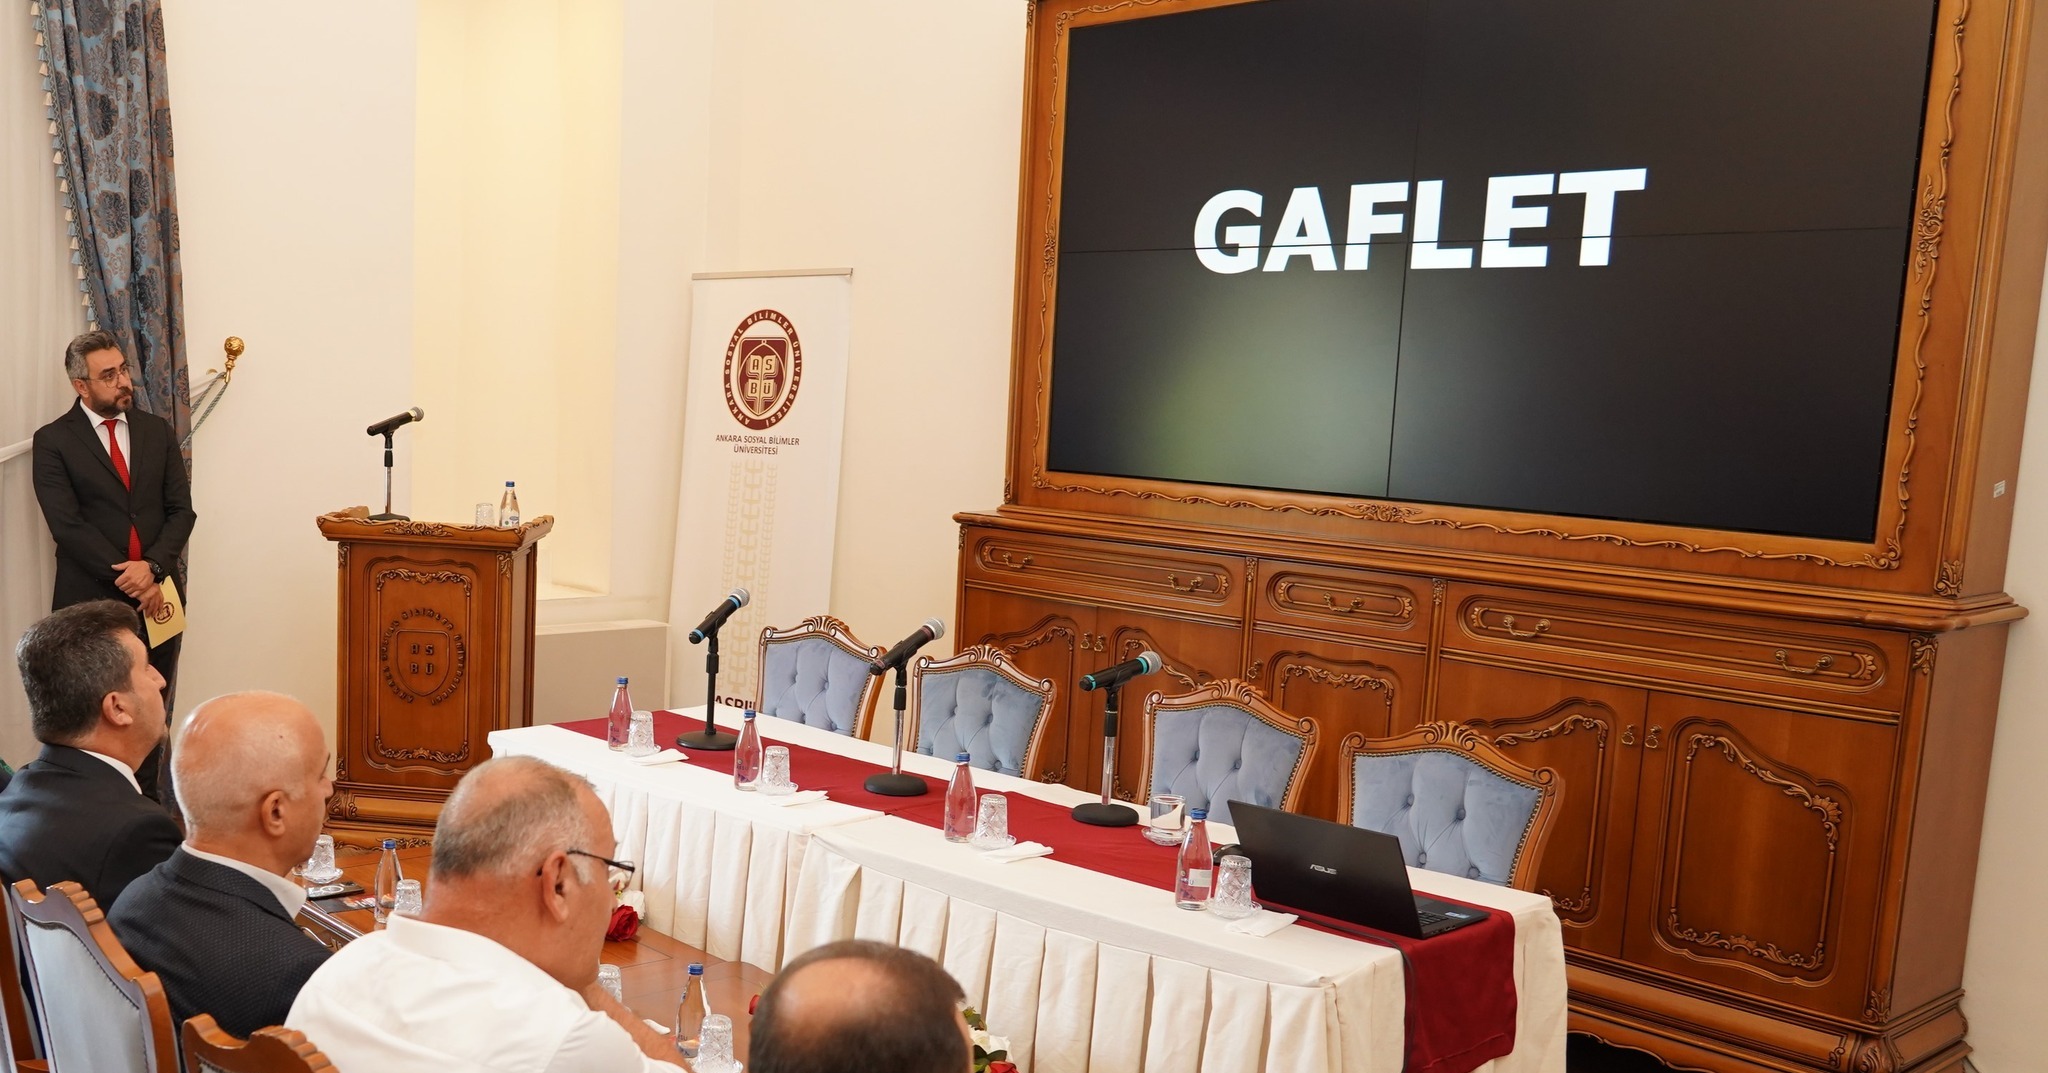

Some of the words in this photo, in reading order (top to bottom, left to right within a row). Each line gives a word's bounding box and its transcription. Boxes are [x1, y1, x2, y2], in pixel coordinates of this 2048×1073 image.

[1194, 168, 1647, 274] GAFLET
[725, 328, 744, 375] SOSYAL
[726, 382, 751, 426] ANKARA
[715, 434, 742, 443] ANKARA
[744, 435, 767, 444] SOSYAL
[768, 435, 800, 446] BİLİMLER
[733, 444, 779, 455] ÜNİVERSİTESİ
[1310, 863, 1337, 875] ASUS
